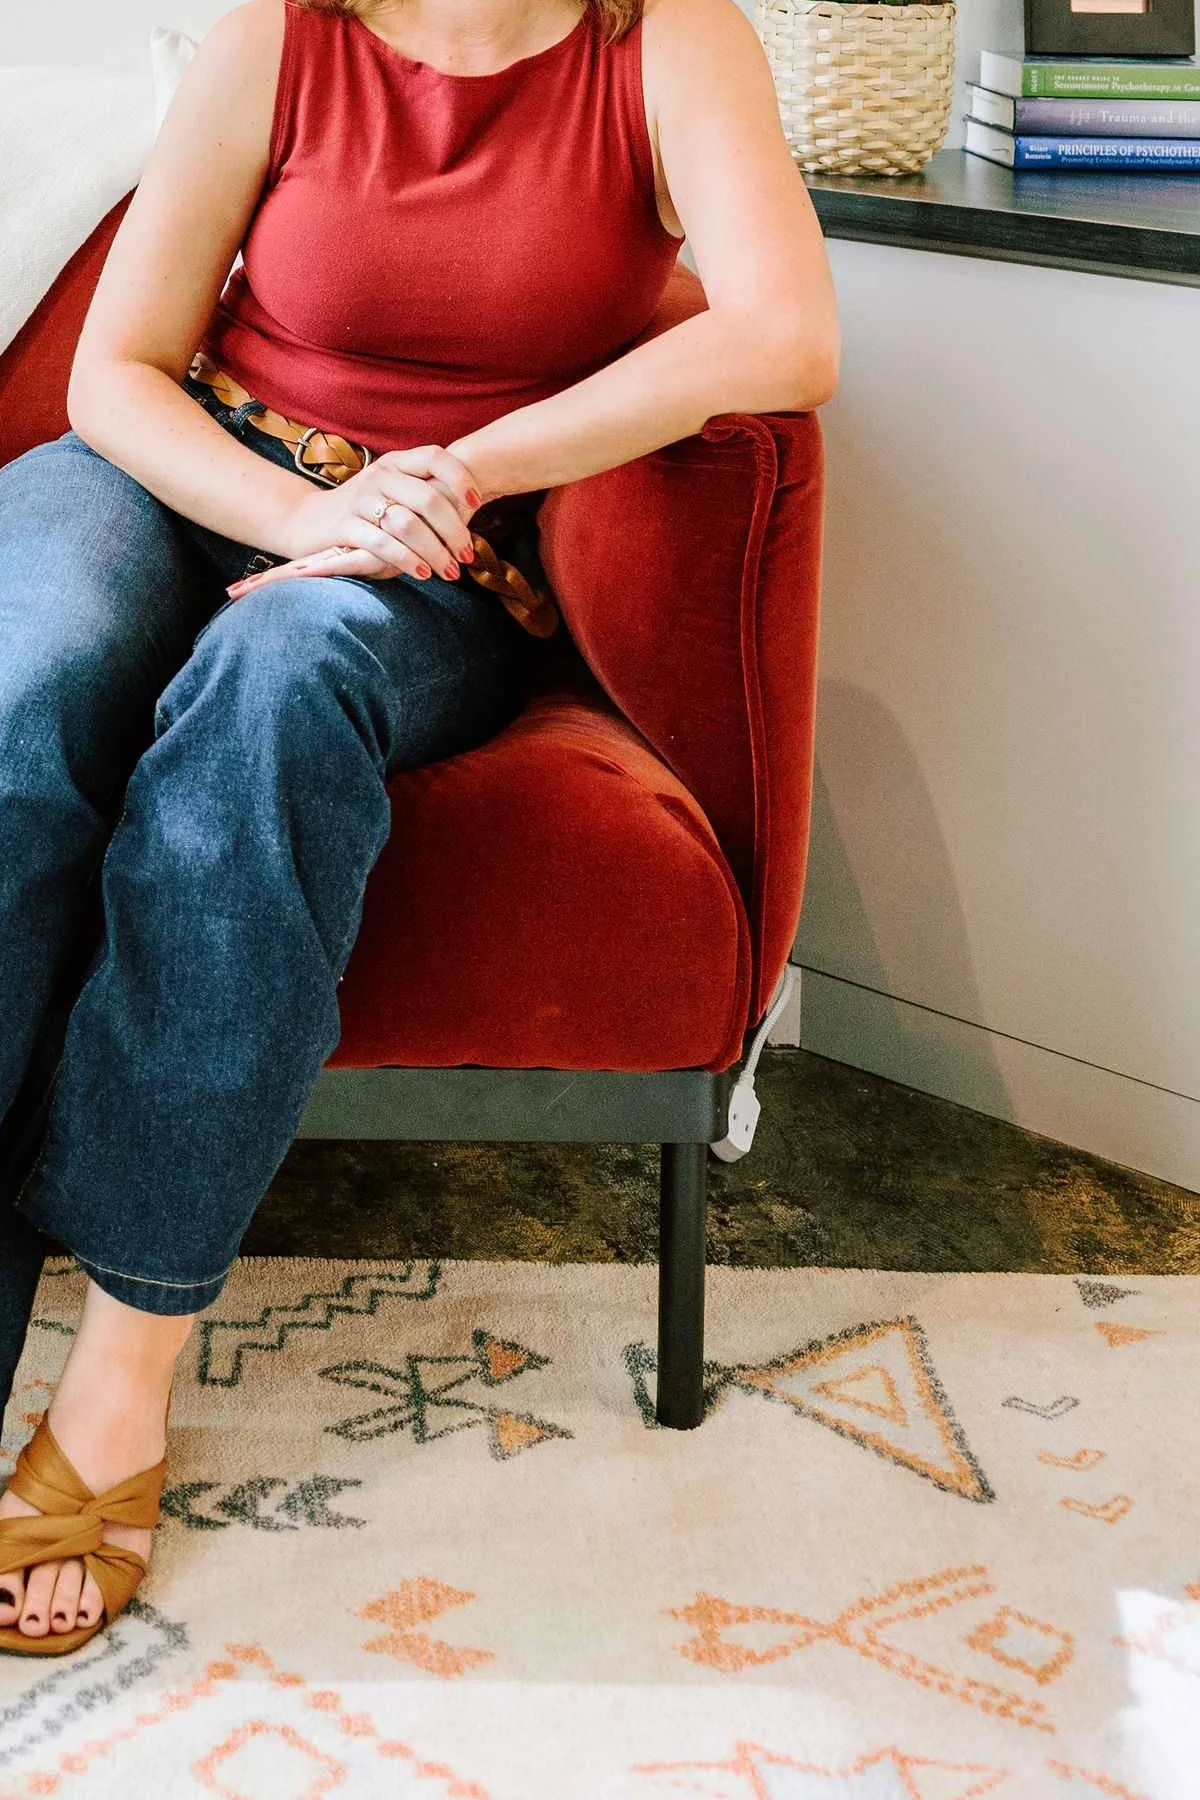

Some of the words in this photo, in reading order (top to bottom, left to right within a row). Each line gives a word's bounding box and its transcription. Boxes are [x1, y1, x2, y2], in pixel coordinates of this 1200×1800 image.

[1100, 110, 1146, 124] Trauma
[1150, 110, 1175, 125] and
[1058, 143, 1117, 156] PRINCIPLES
[1119, 145, 1133, 157] OF
[1135, 145, 1200, 158] PSYCHOTHE
